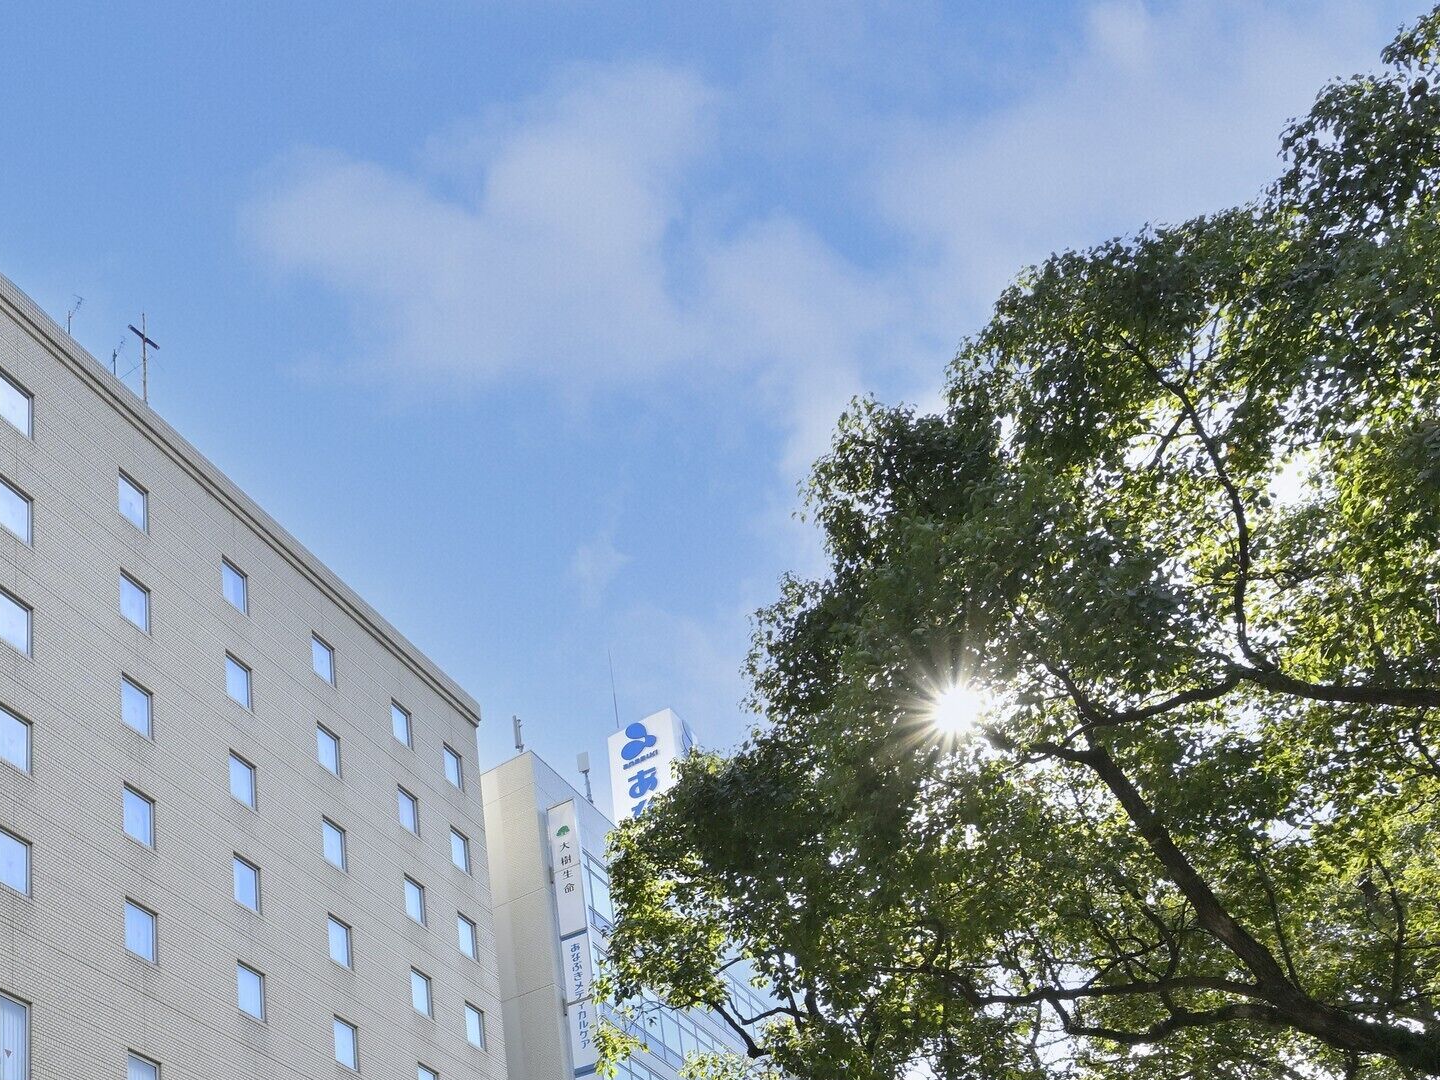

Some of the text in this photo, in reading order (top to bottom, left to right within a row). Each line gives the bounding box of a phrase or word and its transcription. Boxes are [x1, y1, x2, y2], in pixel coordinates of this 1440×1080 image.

[560, 841, 575, 894] 大樹生命
[570, 943, 590, 1049] あなぶきメディカルケア
